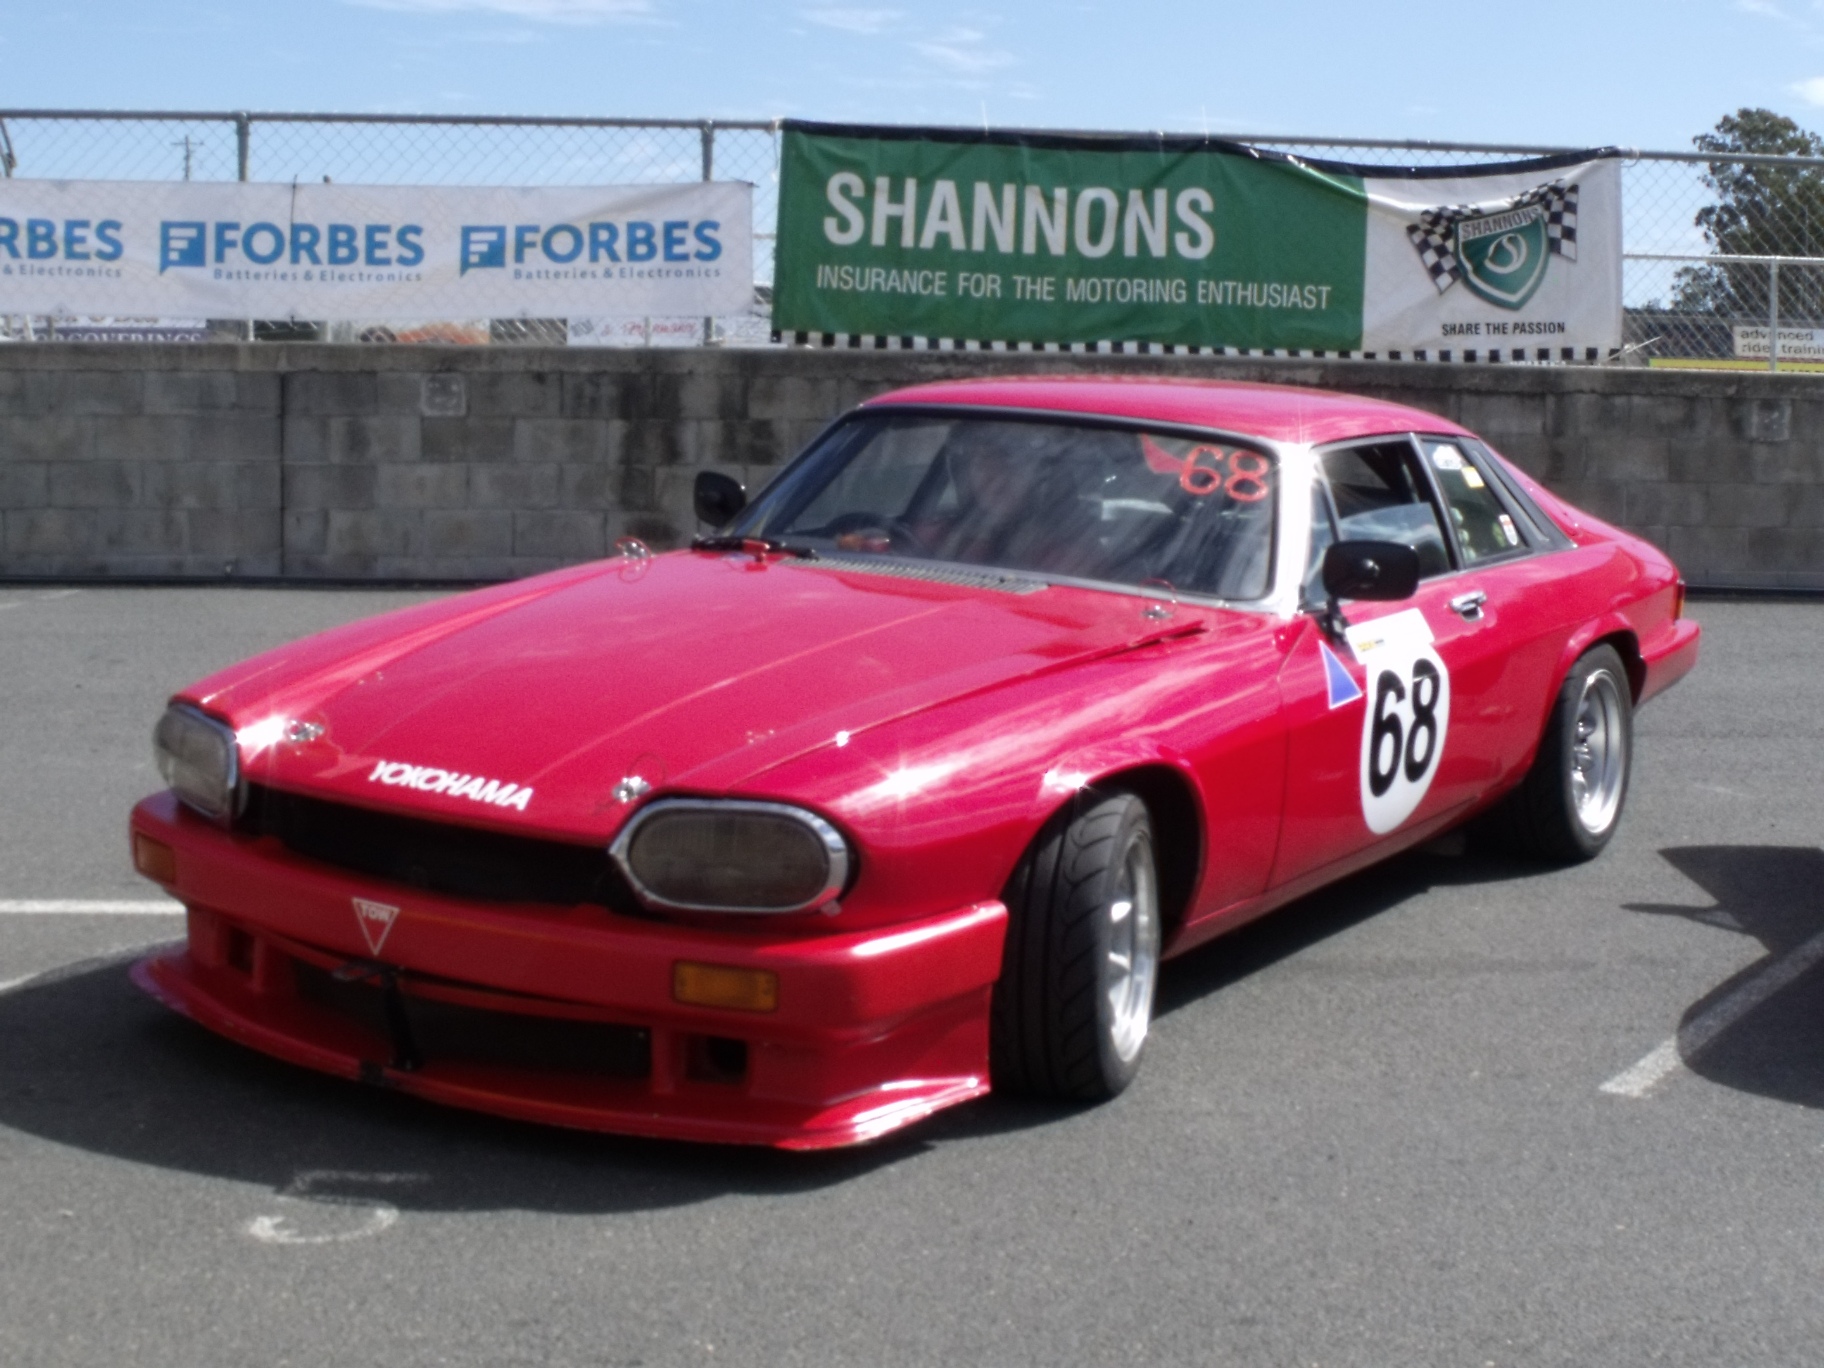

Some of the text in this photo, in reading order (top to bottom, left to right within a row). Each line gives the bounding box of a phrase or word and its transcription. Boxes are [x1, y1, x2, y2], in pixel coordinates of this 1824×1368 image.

[823, 171, 1215, 260] SHANNONS
[1461, 206, 1541, 239] SHANNONS
[214, 221, 425, 267] FORBES
[514, 220, 723, 263] FORBES
[20, 265, 122, 278] Electronics
[213, 269, 422, 282] Batteries & Electronics
[513, 267, 721, 280] Batteries & Electronics
[816, 264, 1332, 310] INSURANCE FOR THE MOTORING ENTHUSIAST
[1442, 322, 1565, 336] SHARE THE PASSION
[1740, 328, 1814, 341] advnced
[1180, 445, 1269, 503] 68
[1368, 658, 1440, 798] 68
[368, 760, 534, 811] YOKOHAMA
[361, 904, 392, 922] TOW
